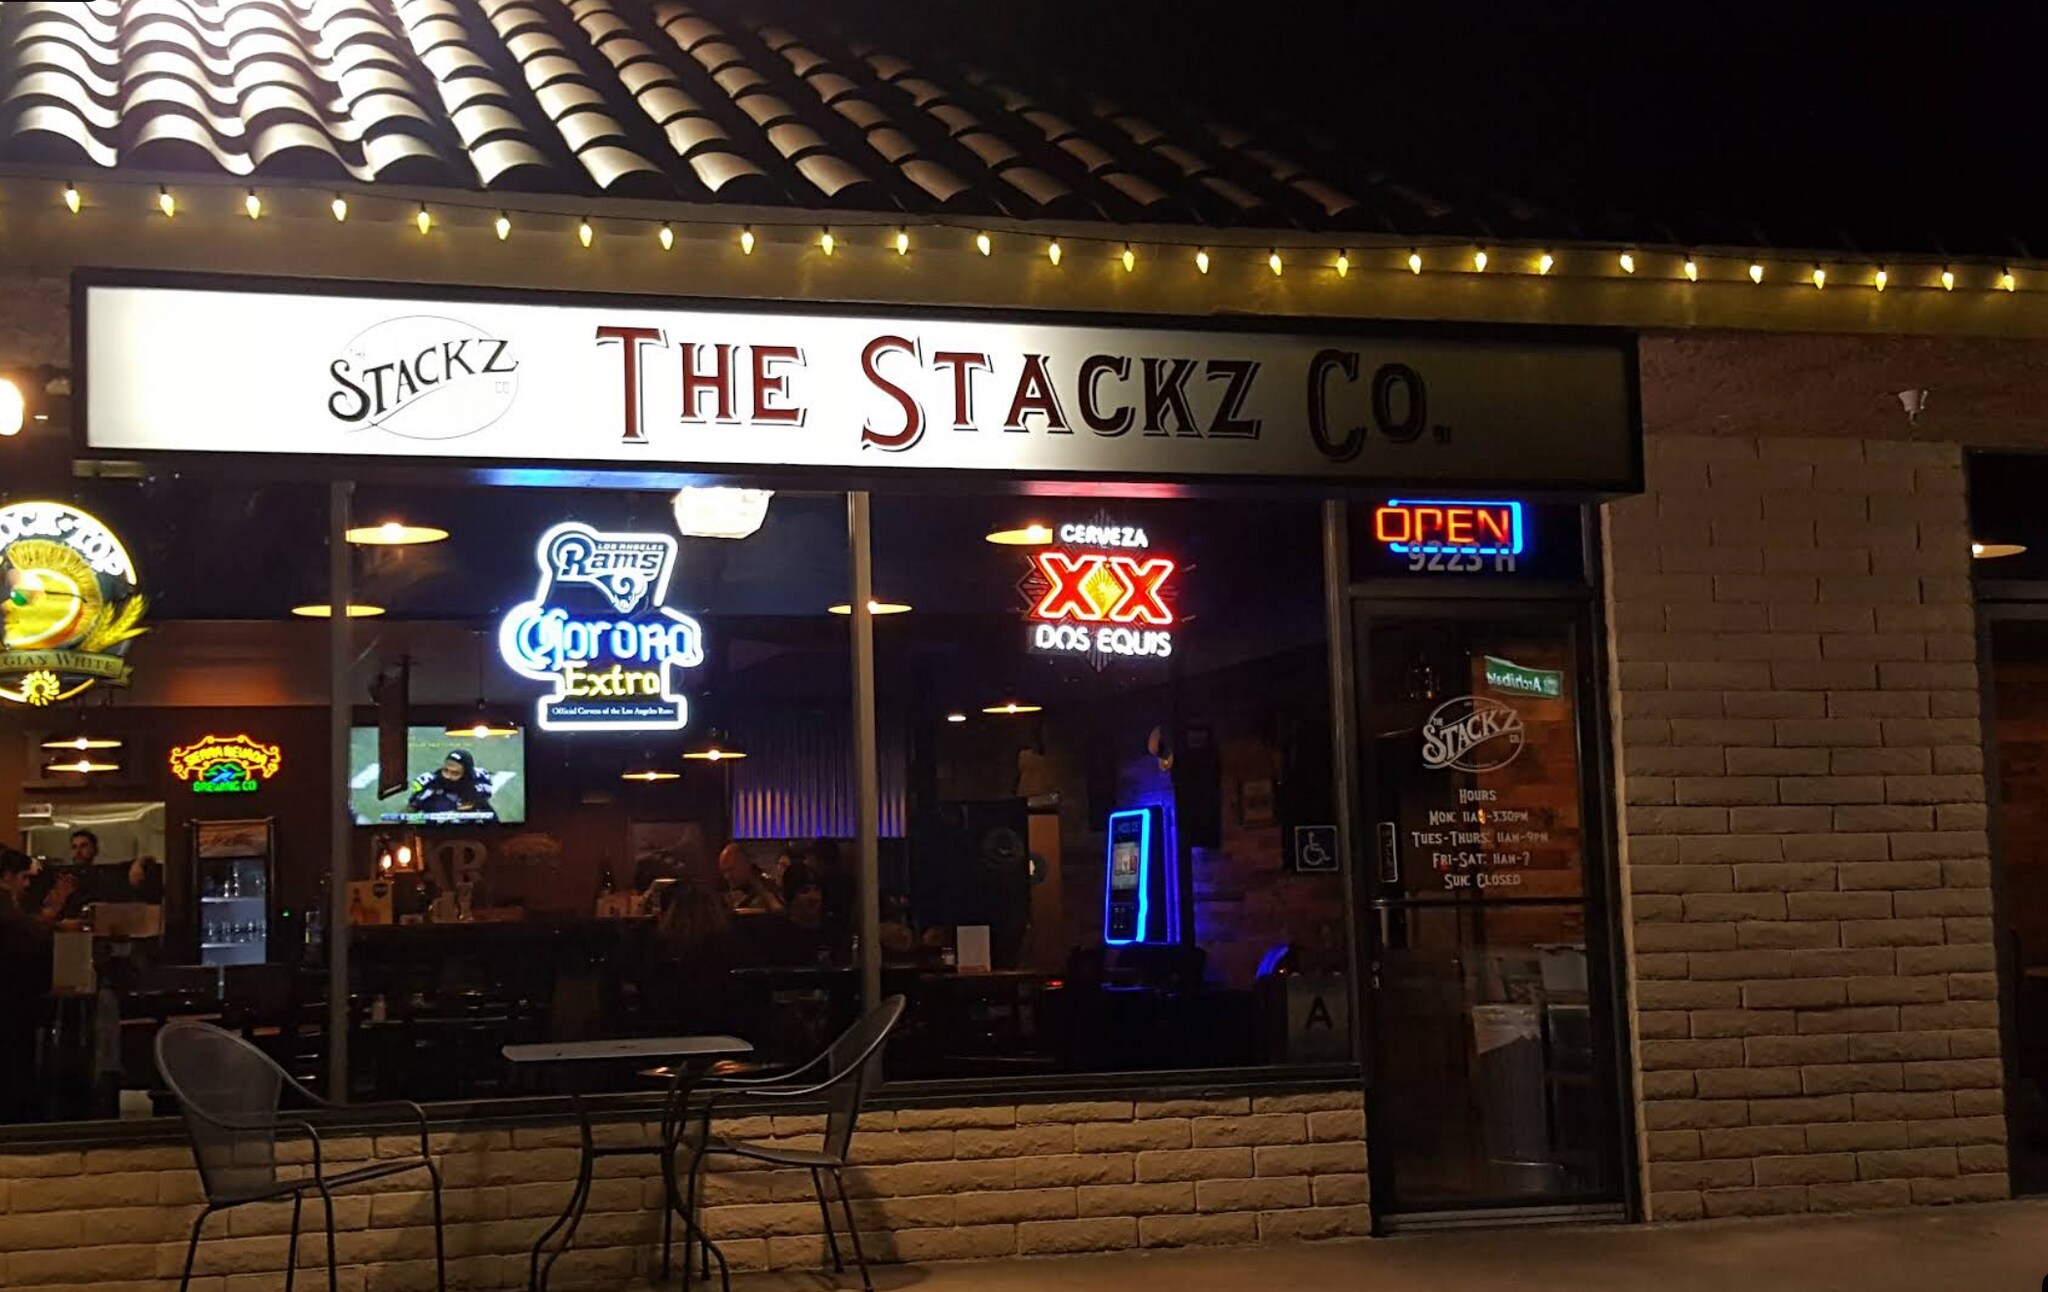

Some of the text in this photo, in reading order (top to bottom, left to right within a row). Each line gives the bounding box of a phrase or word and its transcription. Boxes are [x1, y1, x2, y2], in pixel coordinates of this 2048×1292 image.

[328, 338, 519, 423] STACKZ
[595, 326, 1452, 463] THE STACKZ CO.
[1060, 524, 1148, 548] CERVEZA
[1375, 507, 1509, 543] OPEN
[618, 543, 665, 551] ANGELES
[1038, 552, 1174, 624] XX
[514, 608, 693, 671] Corona
[1035, 624, 1172, 657] DOS EQUIS
[55, 653, 113, 671] WHITE
[562, 660, 661, 697] Extra
[1421, 708, 1524, 764] STACKZ
[242, 780, 257, 791] CO
[1459, 788, 1498, 804] HOURS
[1476, 873, 1521, 889] CLOSED
[1305, 997, 1333, 1030] A
